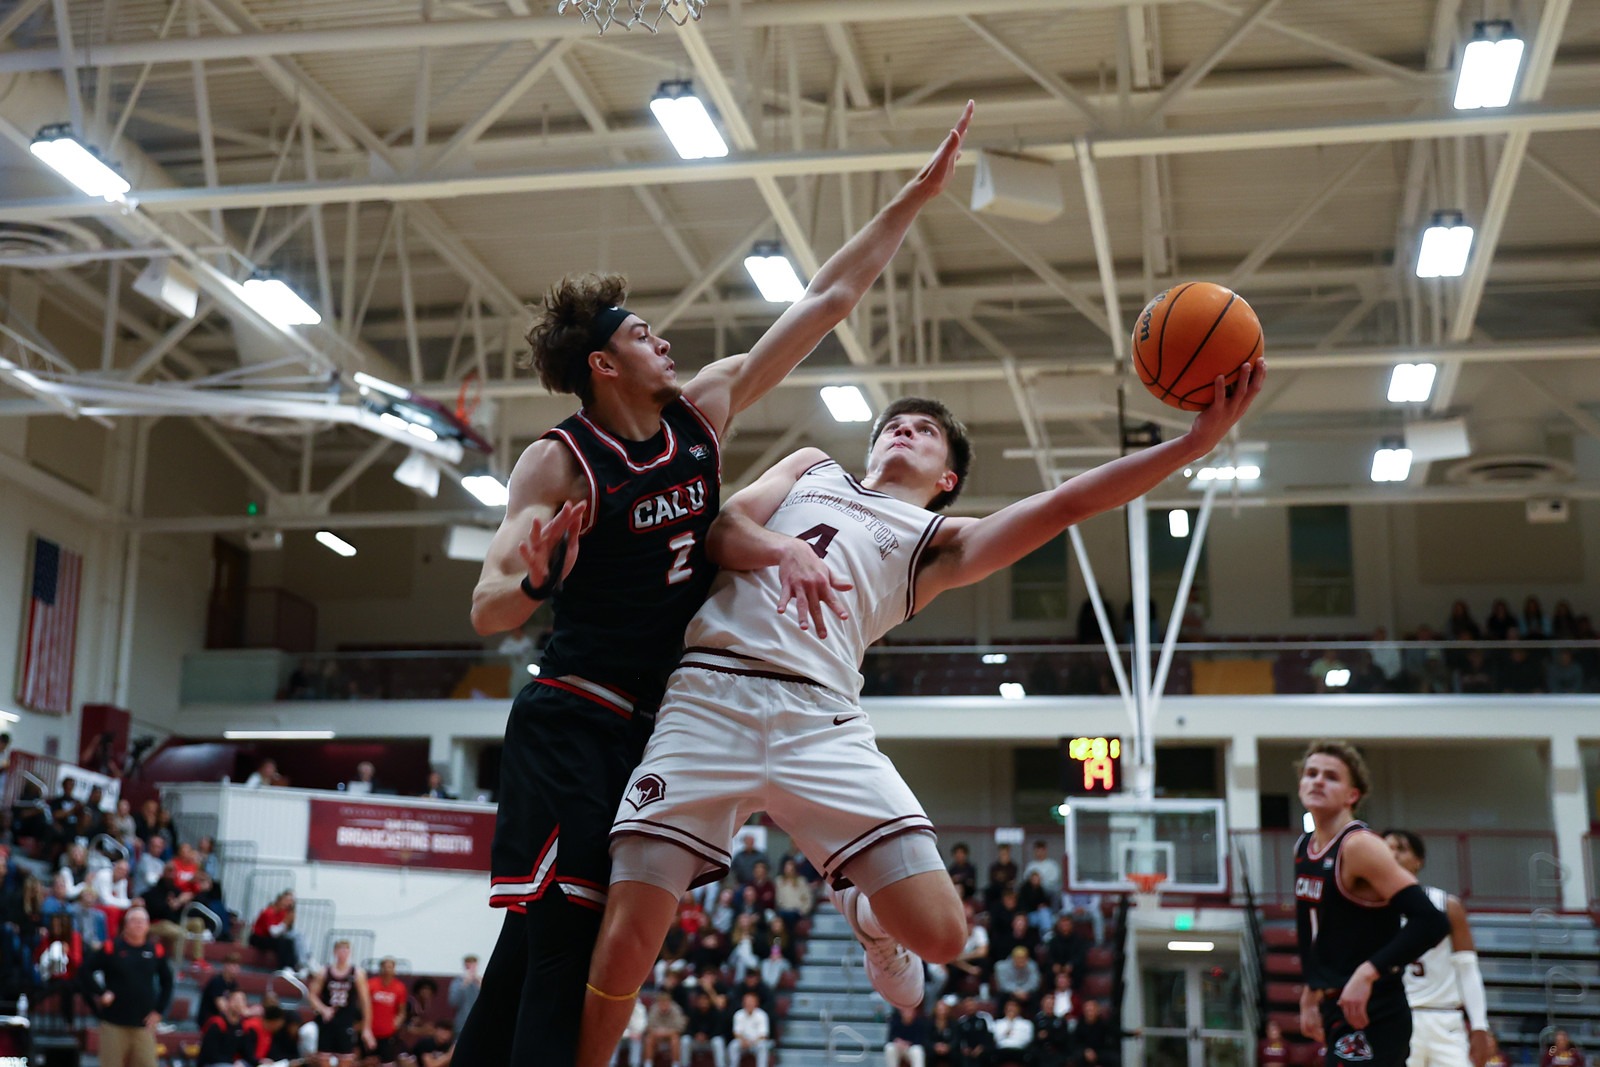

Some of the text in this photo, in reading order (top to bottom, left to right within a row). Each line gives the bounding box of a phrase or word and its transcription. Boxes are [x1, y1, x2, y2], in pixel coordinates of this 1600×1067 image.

[667, 531, 696, 585] 2
[795, 523, 839, 560] 4
[1309, 907, 1319, 944] 1
